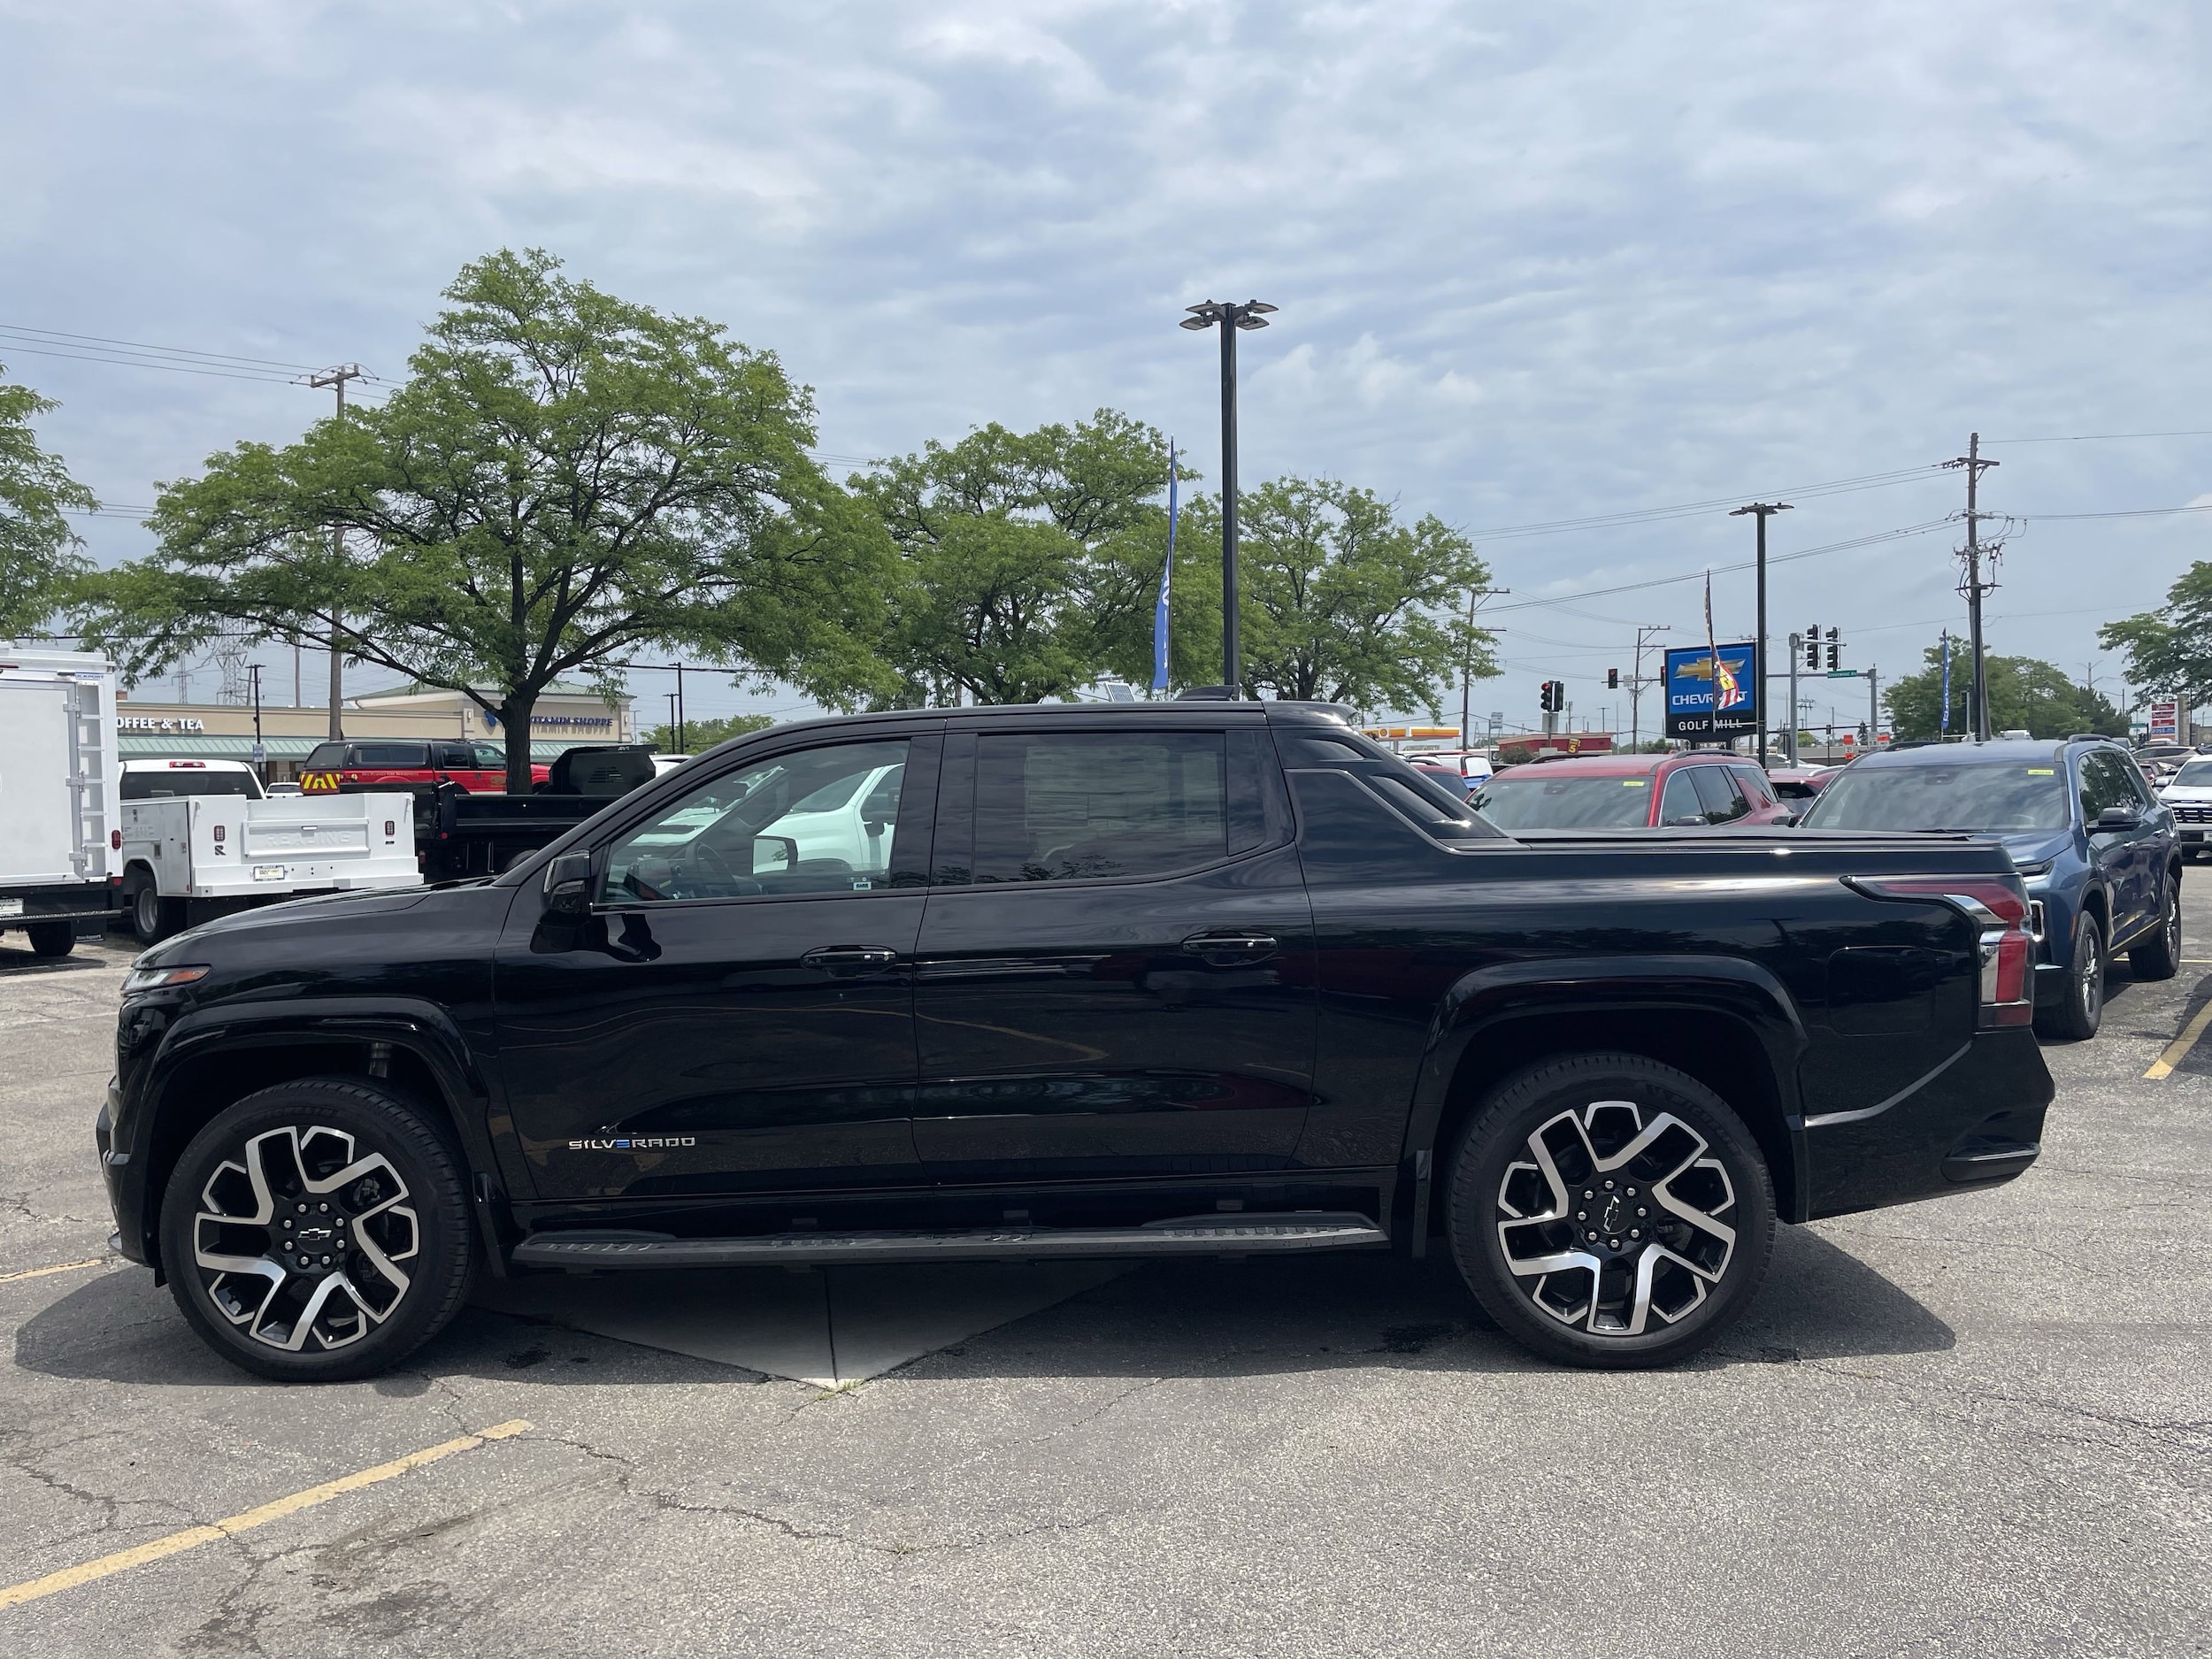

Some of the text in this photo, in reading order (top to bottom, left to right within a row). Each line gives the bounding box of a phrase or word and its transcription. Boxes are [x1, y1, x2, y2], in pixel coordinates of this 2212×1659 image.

[1672, 691, 1748, 706] CHEVRT
[117, 718, 204, 730] OFFEE & TEA
[572, 717, 613, 726] SHOPPE
[1678, 718, 1743, 731] GOLF MILL
[266, 832, 351, 847] READING
[569, 1137, 695, 1150] SILVERADO
